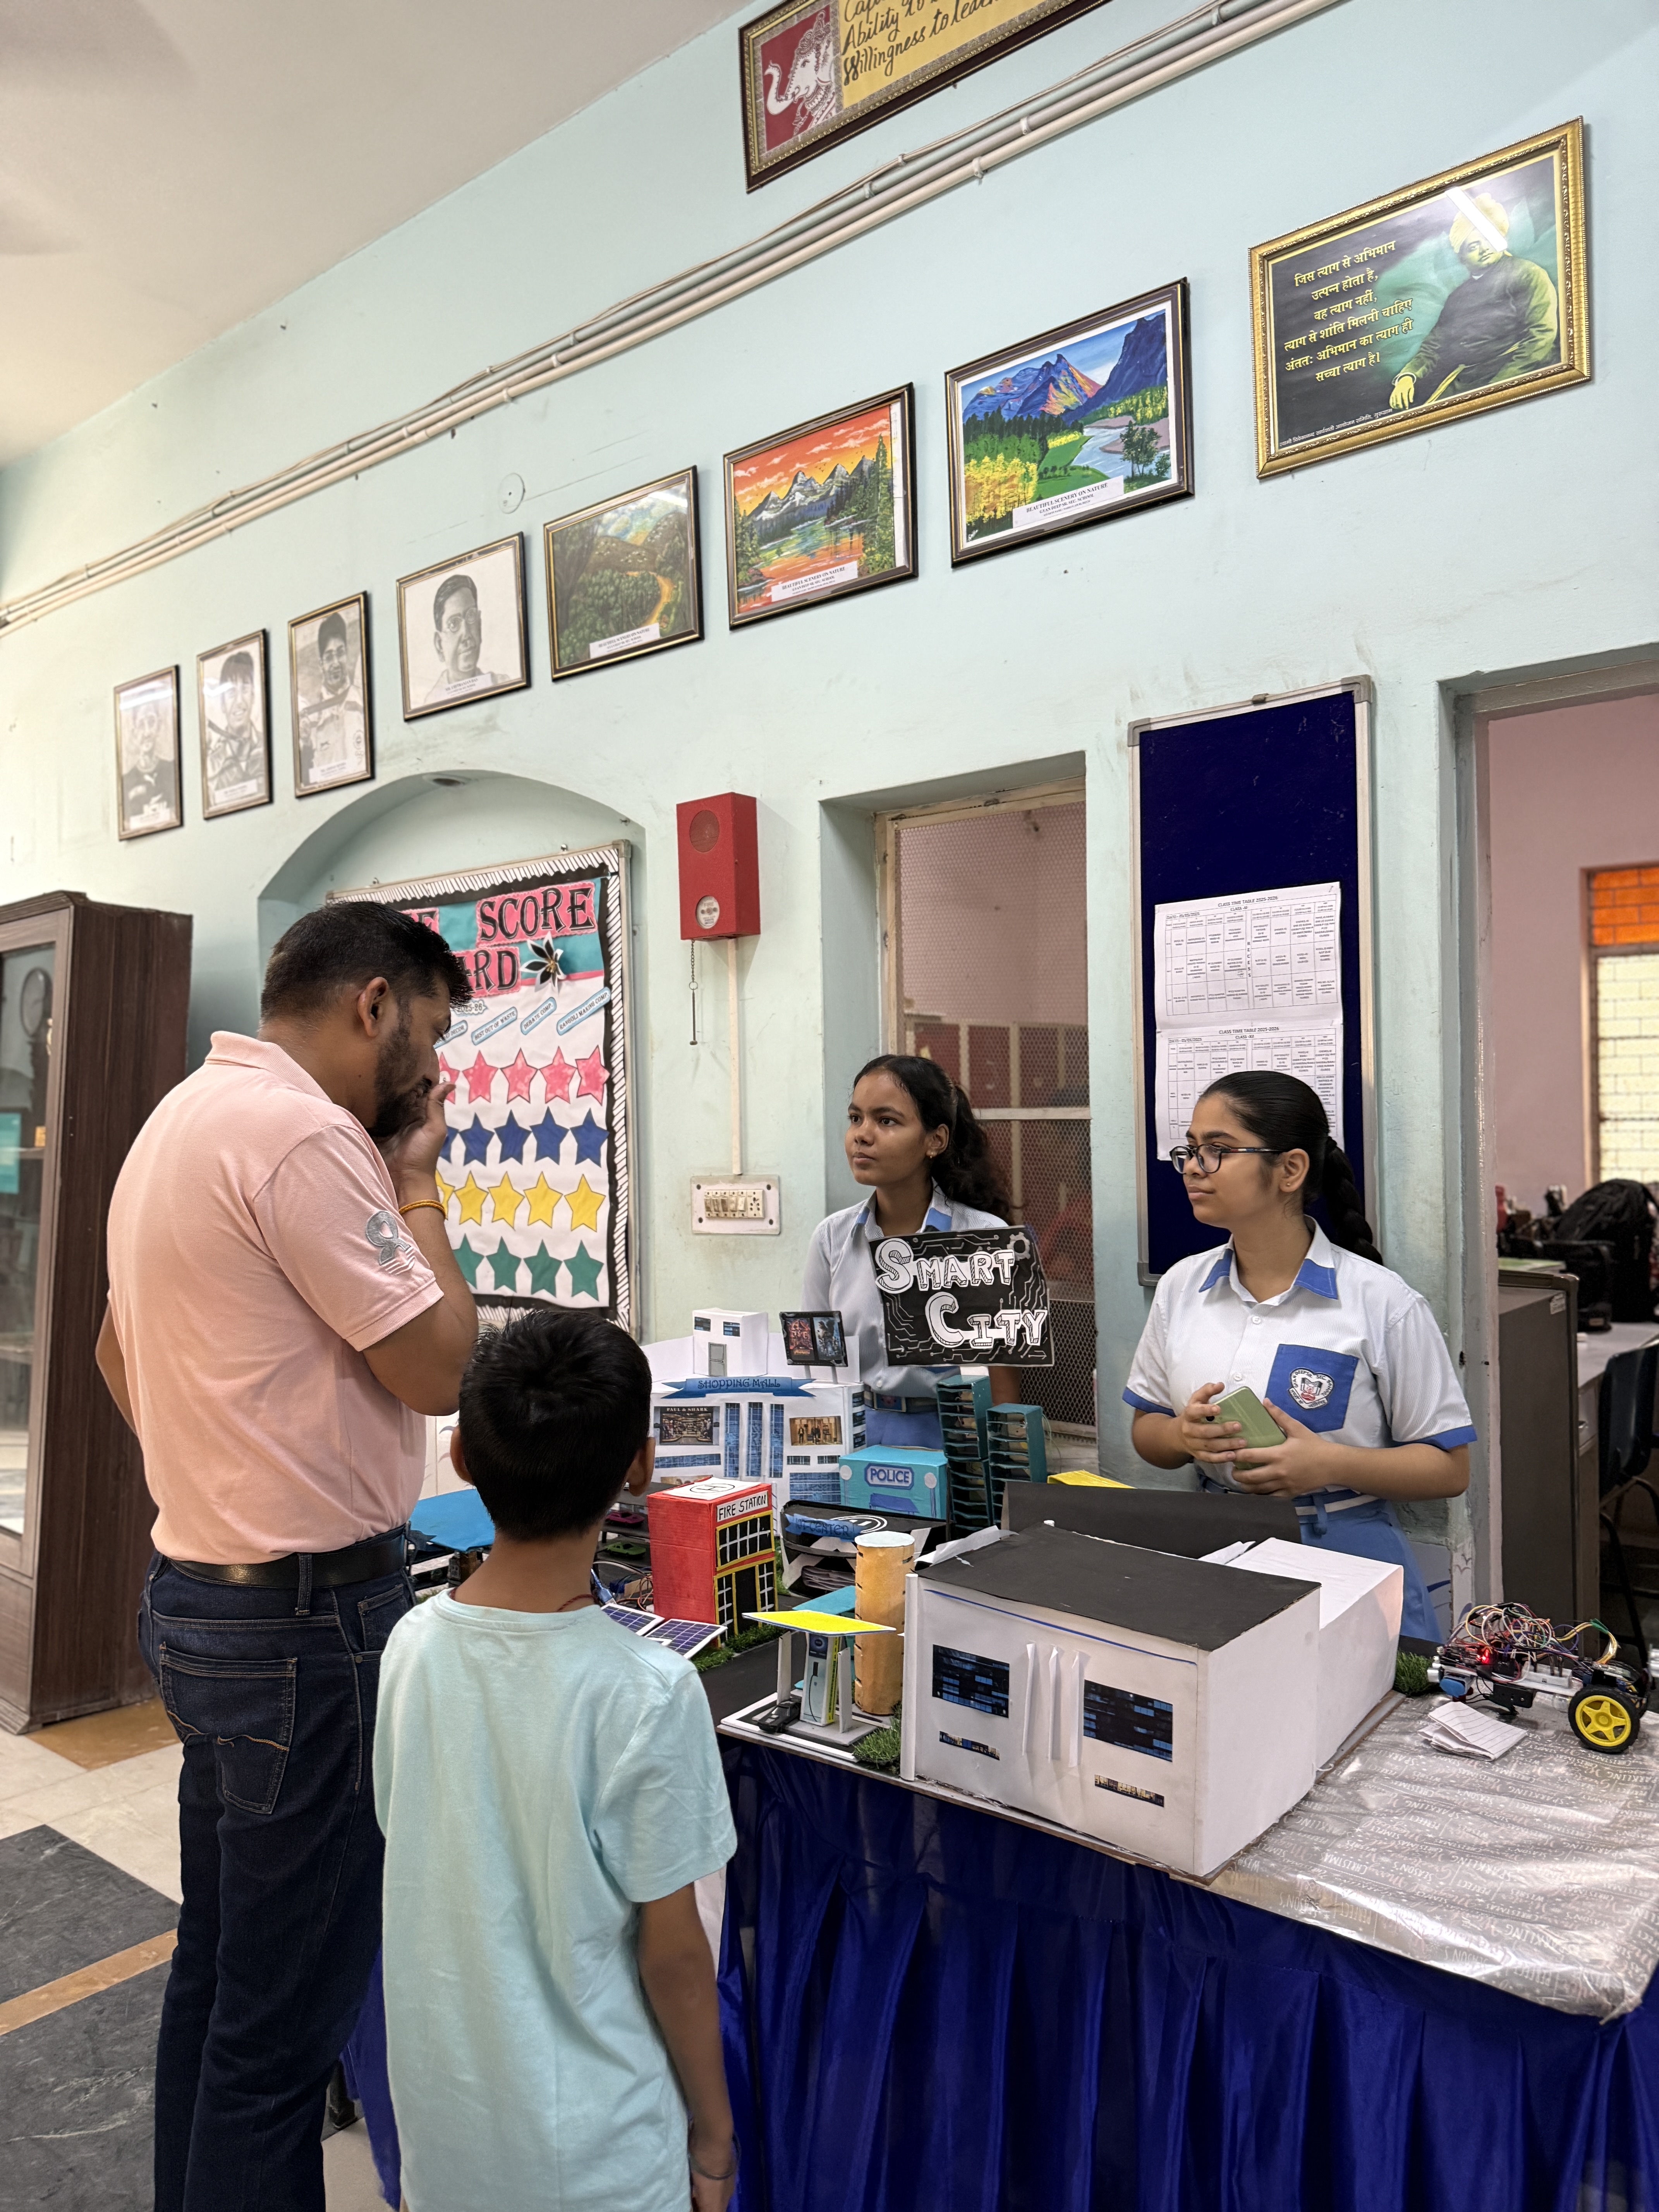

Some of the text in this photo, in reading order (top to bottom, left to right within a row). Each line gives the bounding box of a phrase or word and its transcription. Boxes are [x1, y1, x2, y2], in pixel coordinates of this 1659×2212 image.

[842, 8, 900, 55] Ability
[843, 26, 926, 86] Willingness
[929, 9, 949, 38] to
[1295, 240, 1396, 287] जिस त्याग से अभिमान
[1312, 267, 1378, 301] उत्पन्न होता है,
[1314, 289, 1377, 321] वह त्याग नहीं,
[1284, 298, 1413, 352] त्याग से शांति मिलनी चाहिए
[1317, 339, 1357, 362] अभिमान
[1360, 333, 1373, 347] का
[1376, 325, 1400, 342] त्याग
[1401, 318, 1413, 334] ही
[1316, 365, 1341, 382] सच्चा
[1343, 357, 1367, 373] त्याग
[1026, 500, 1054, 513] BEAUTIFUL
[1054, 493, 1078, 504] SCENERY
[1087, 483, 1108, 493] NATURE
[480, 887, 596, 941] SCORE
[523, 1012, 541, 1030] DEBATE
[559, 992, 610, 1030] RANGOLI MAKING COMP.
[450, 1025, 465, 1036] DECOR
[474, 1030, 484, 1040] BEST
[485, 1025, 494, 1034] OUT
[500, 1011, 516, 1024] WASTE
[875, 1238, 1015, 1294] SMART
[925, 1291, 1048, 1349] CITY
[697, 1378, 781, 1389] SHOPPING MALL
[870, 1468, 910, 1484] POLICE
[719, 1494, 766, 1520] FIRE STATION
[1300, 1800, 1329, 1812] CHRIST
[1508, 1786, 1564, 1805] SPARKLING
[1404, 1800, 1460, 1819] SPARKLING
[1369, 1826, 1400, 1839] SIMPLY
[1321, 1852, 1368, 1875] CHRISTMAS
[1392, 1861, 1434, 1882] SEASON'S
[1450, 1855, 1511, 1882] SPARKLING
[1456, 1879, 1491, 1896] PERFECT
[1486, 1903, 1539, 1921] CHRISTMAS
